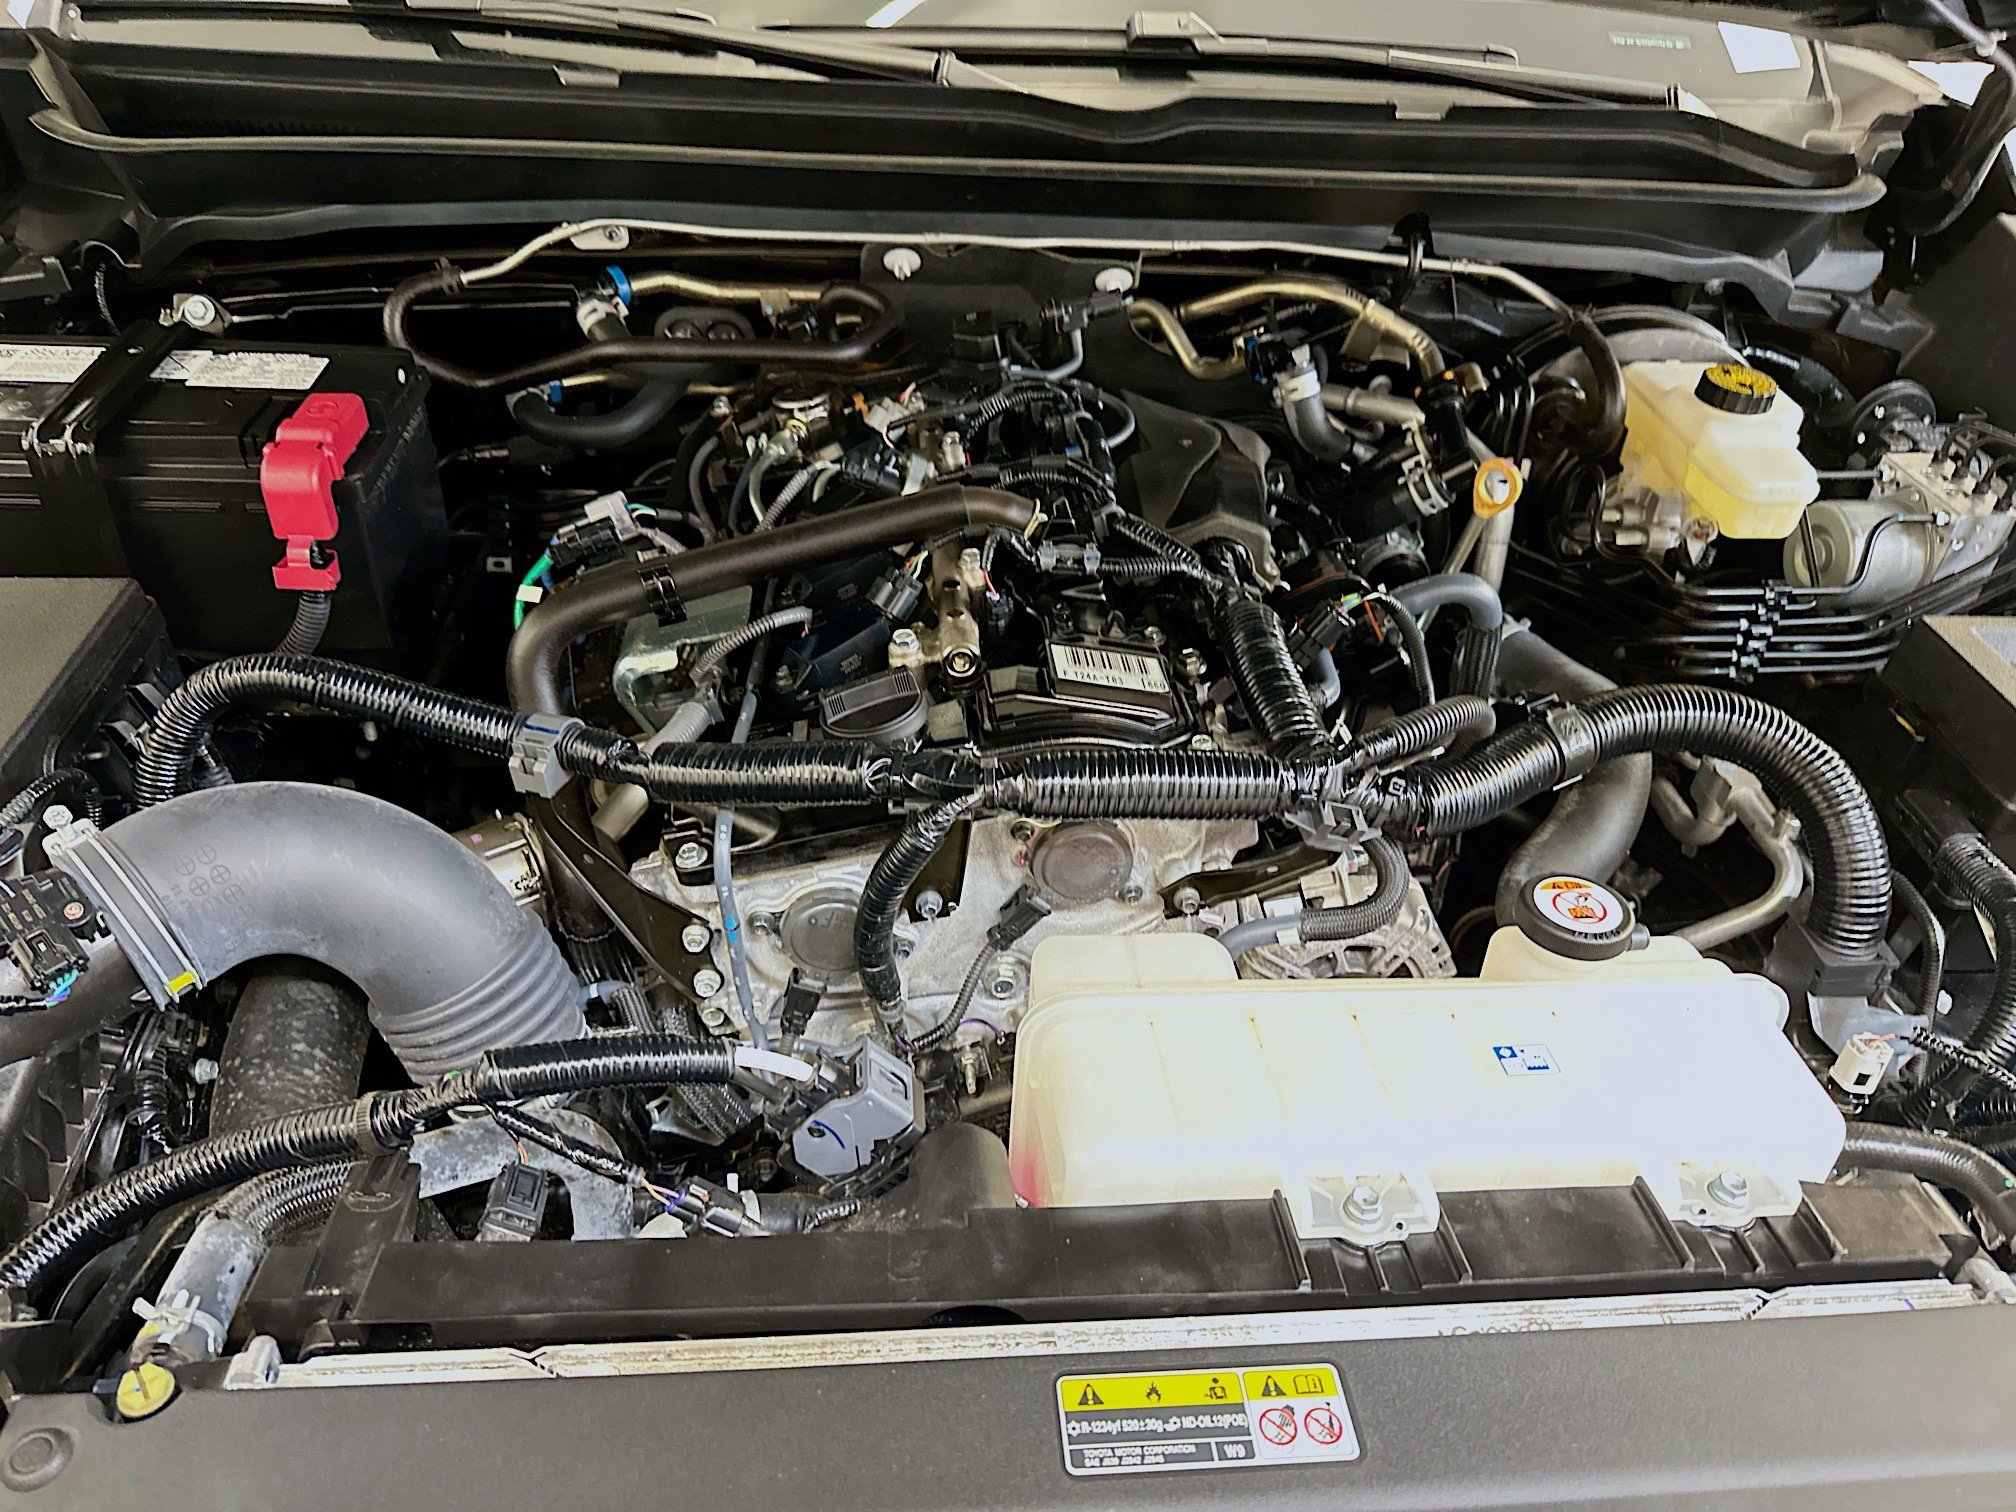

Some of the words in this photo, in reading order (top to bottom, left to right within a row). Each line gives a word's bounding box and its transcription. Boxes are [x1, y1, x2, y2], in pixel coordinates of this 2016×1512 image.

[1083, 1448, 1113, 1458] TOYOTA
[1114, 1447, 1142, 1457] MOTOR
[1143, 1444, 1196, 1456] CORPORATION
[1223, 1444, 1246, 1459] W9
